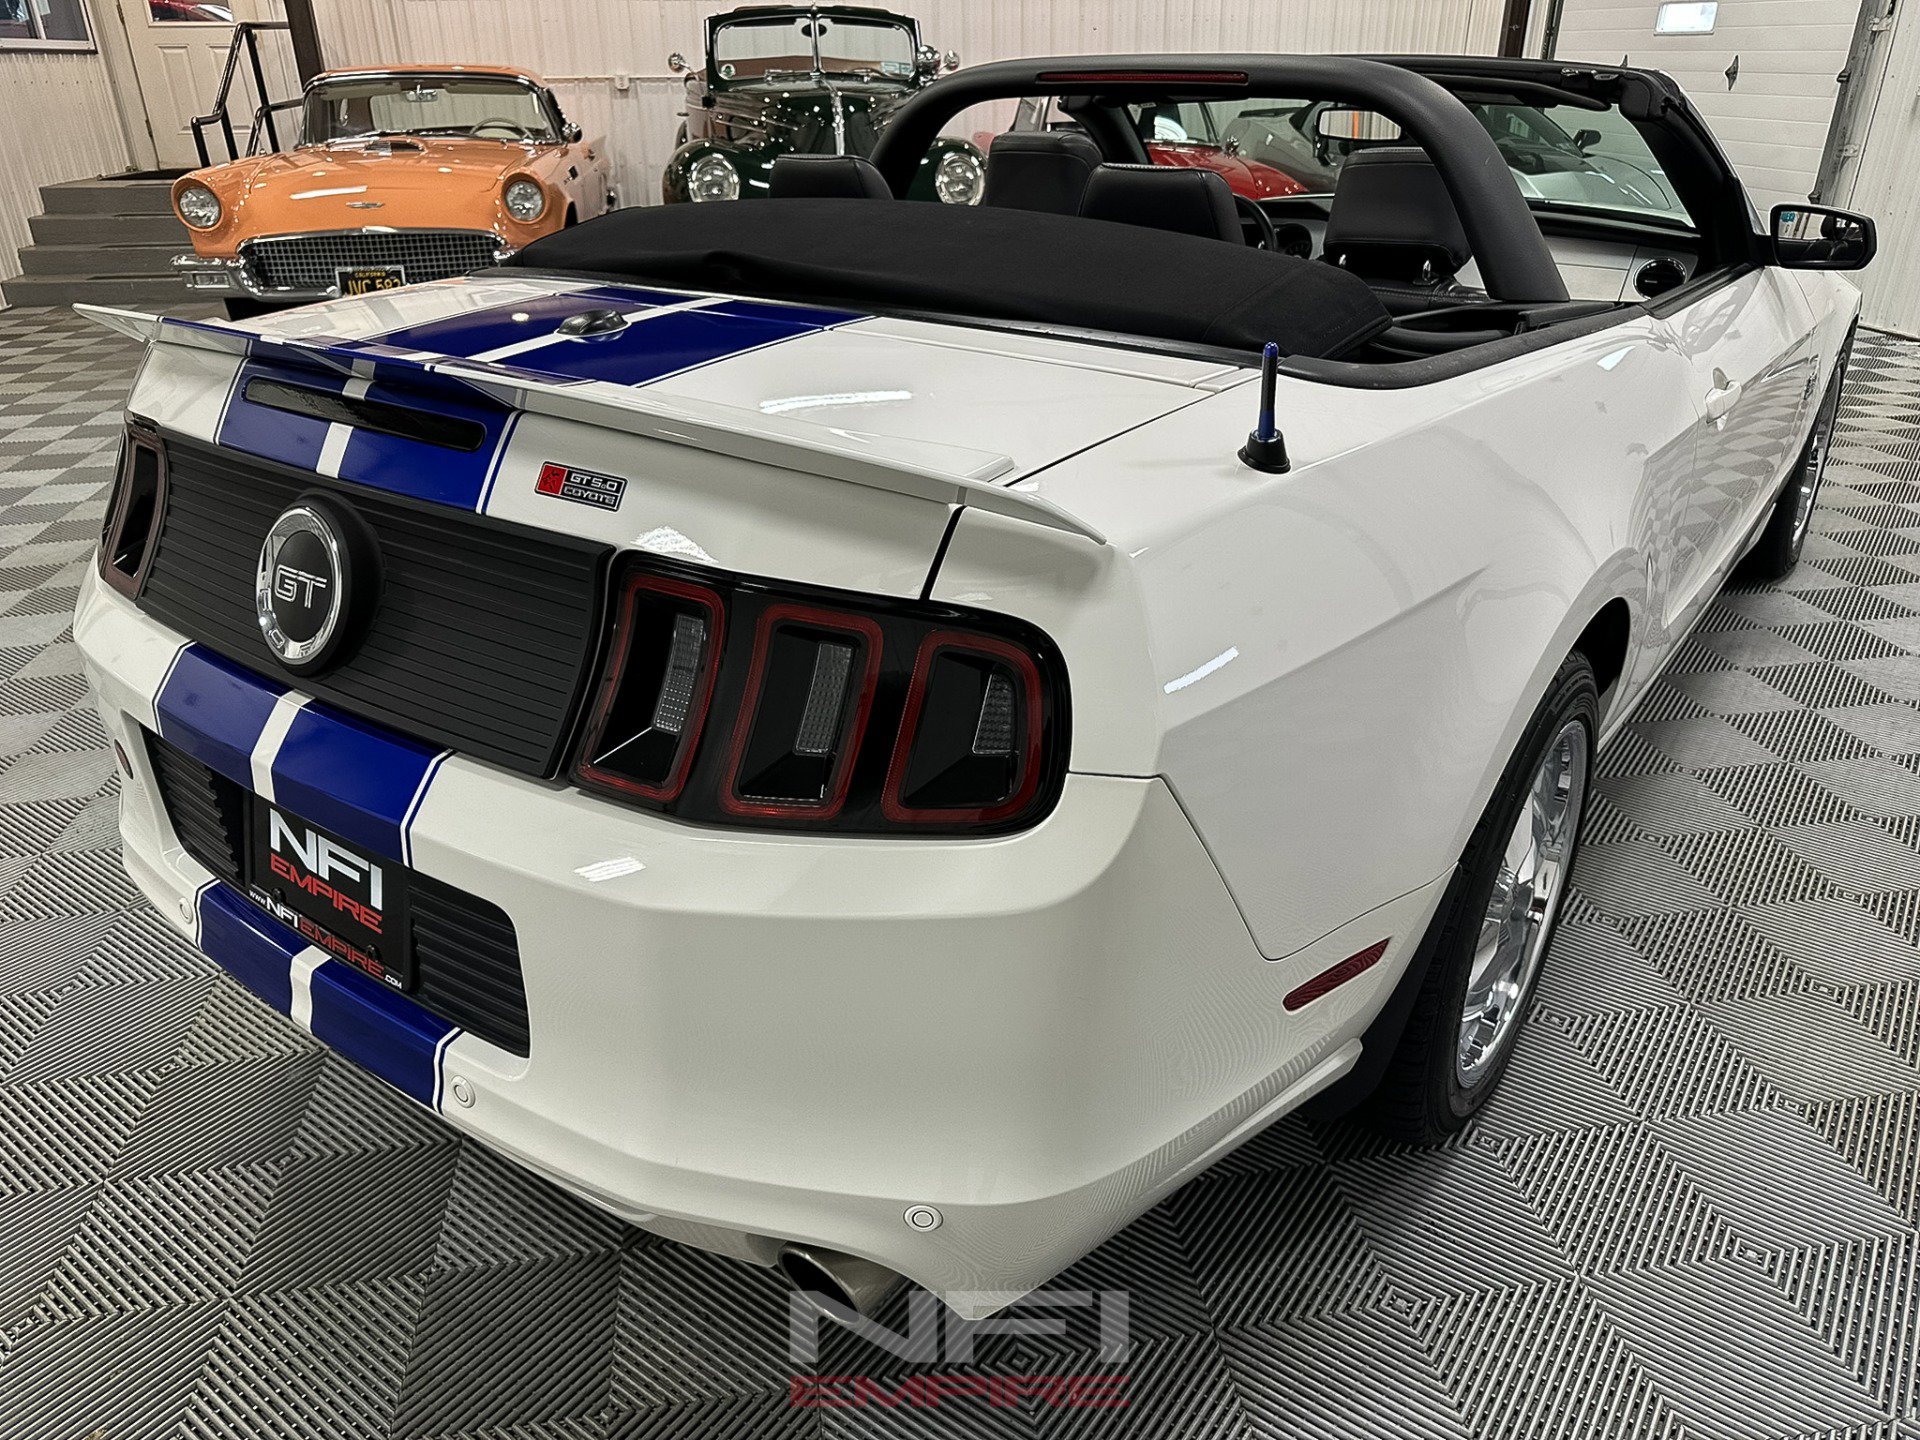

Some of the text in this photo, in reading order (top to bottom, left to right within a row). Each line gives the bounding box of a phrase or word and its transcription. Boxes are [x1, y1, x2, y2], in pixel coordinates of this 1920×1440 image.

[563, 486, 615, 505] COYOTE
[274, 563, 327, 609] GT
[270, 807, 382, 911] NFI
[270, 852, 383, 935] EMPIRE
